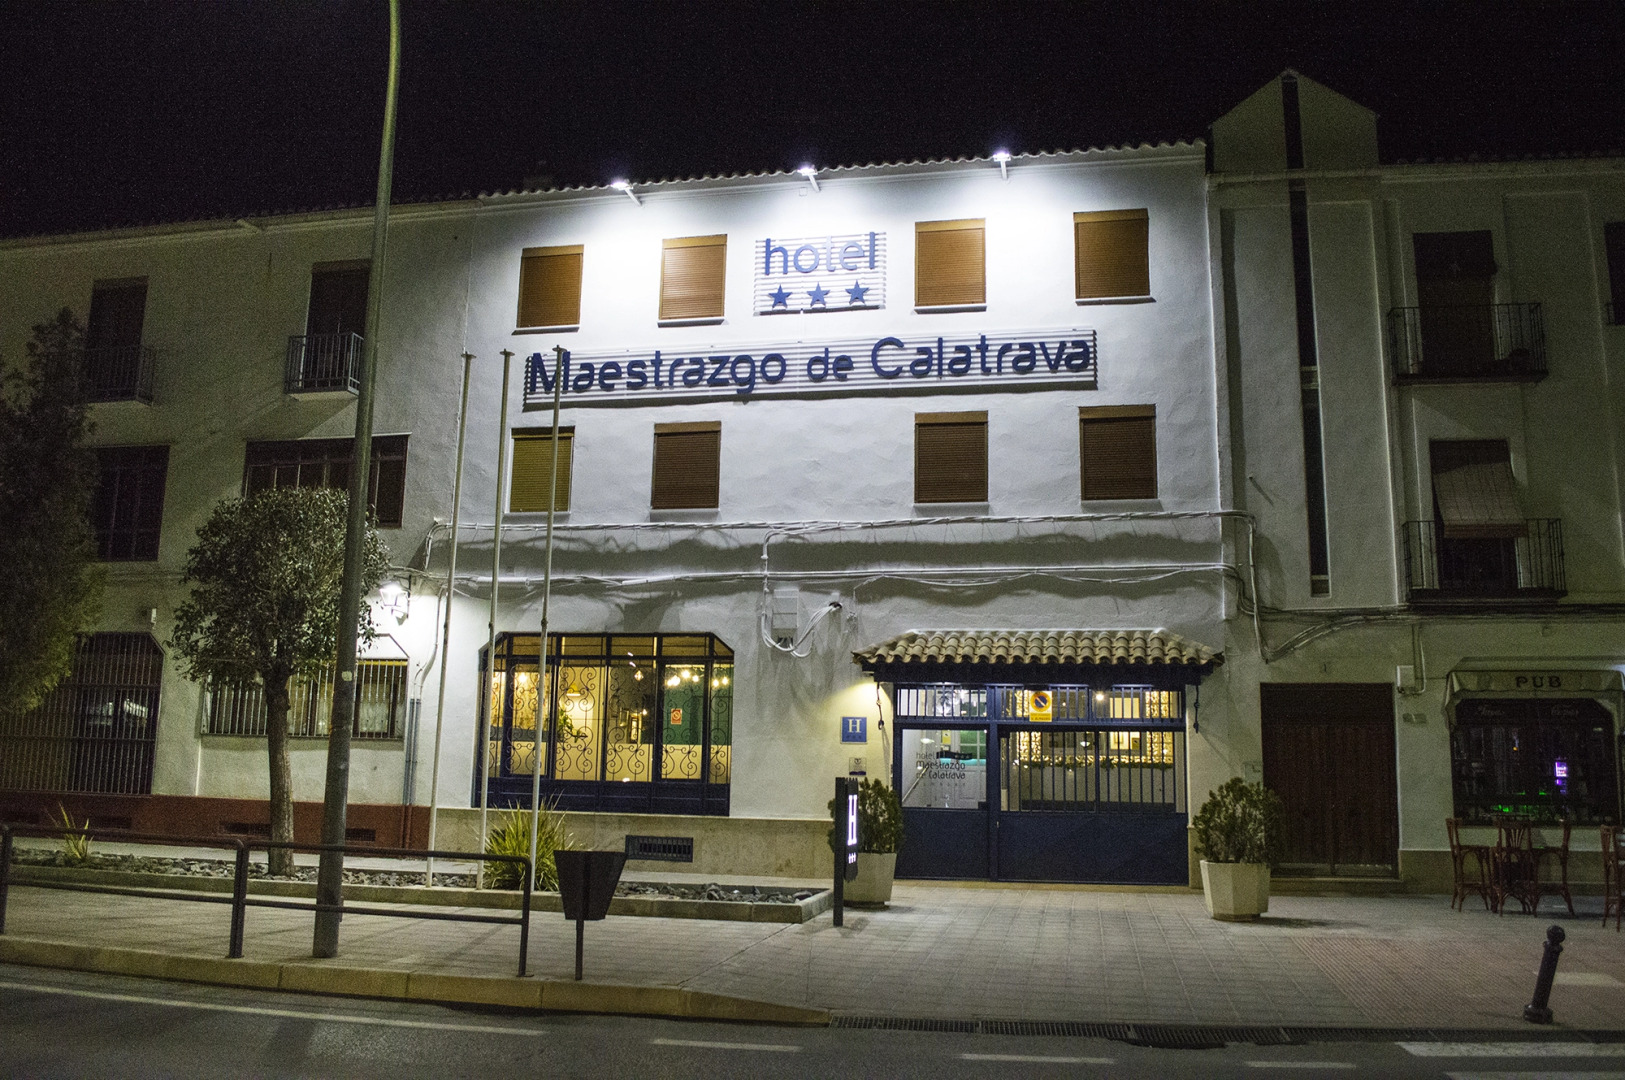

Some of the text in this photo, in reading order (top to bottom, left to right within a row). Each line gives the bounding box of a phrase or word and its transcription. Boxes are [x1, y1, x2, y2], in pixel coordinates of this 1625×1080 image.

[765, 232, 875, 275] hotel
[529, 335, 1091, 394] Maestrazgo de Calatrava
[1515, 676, 1561, 688] PUB
[847, 718, 863, 733] H
